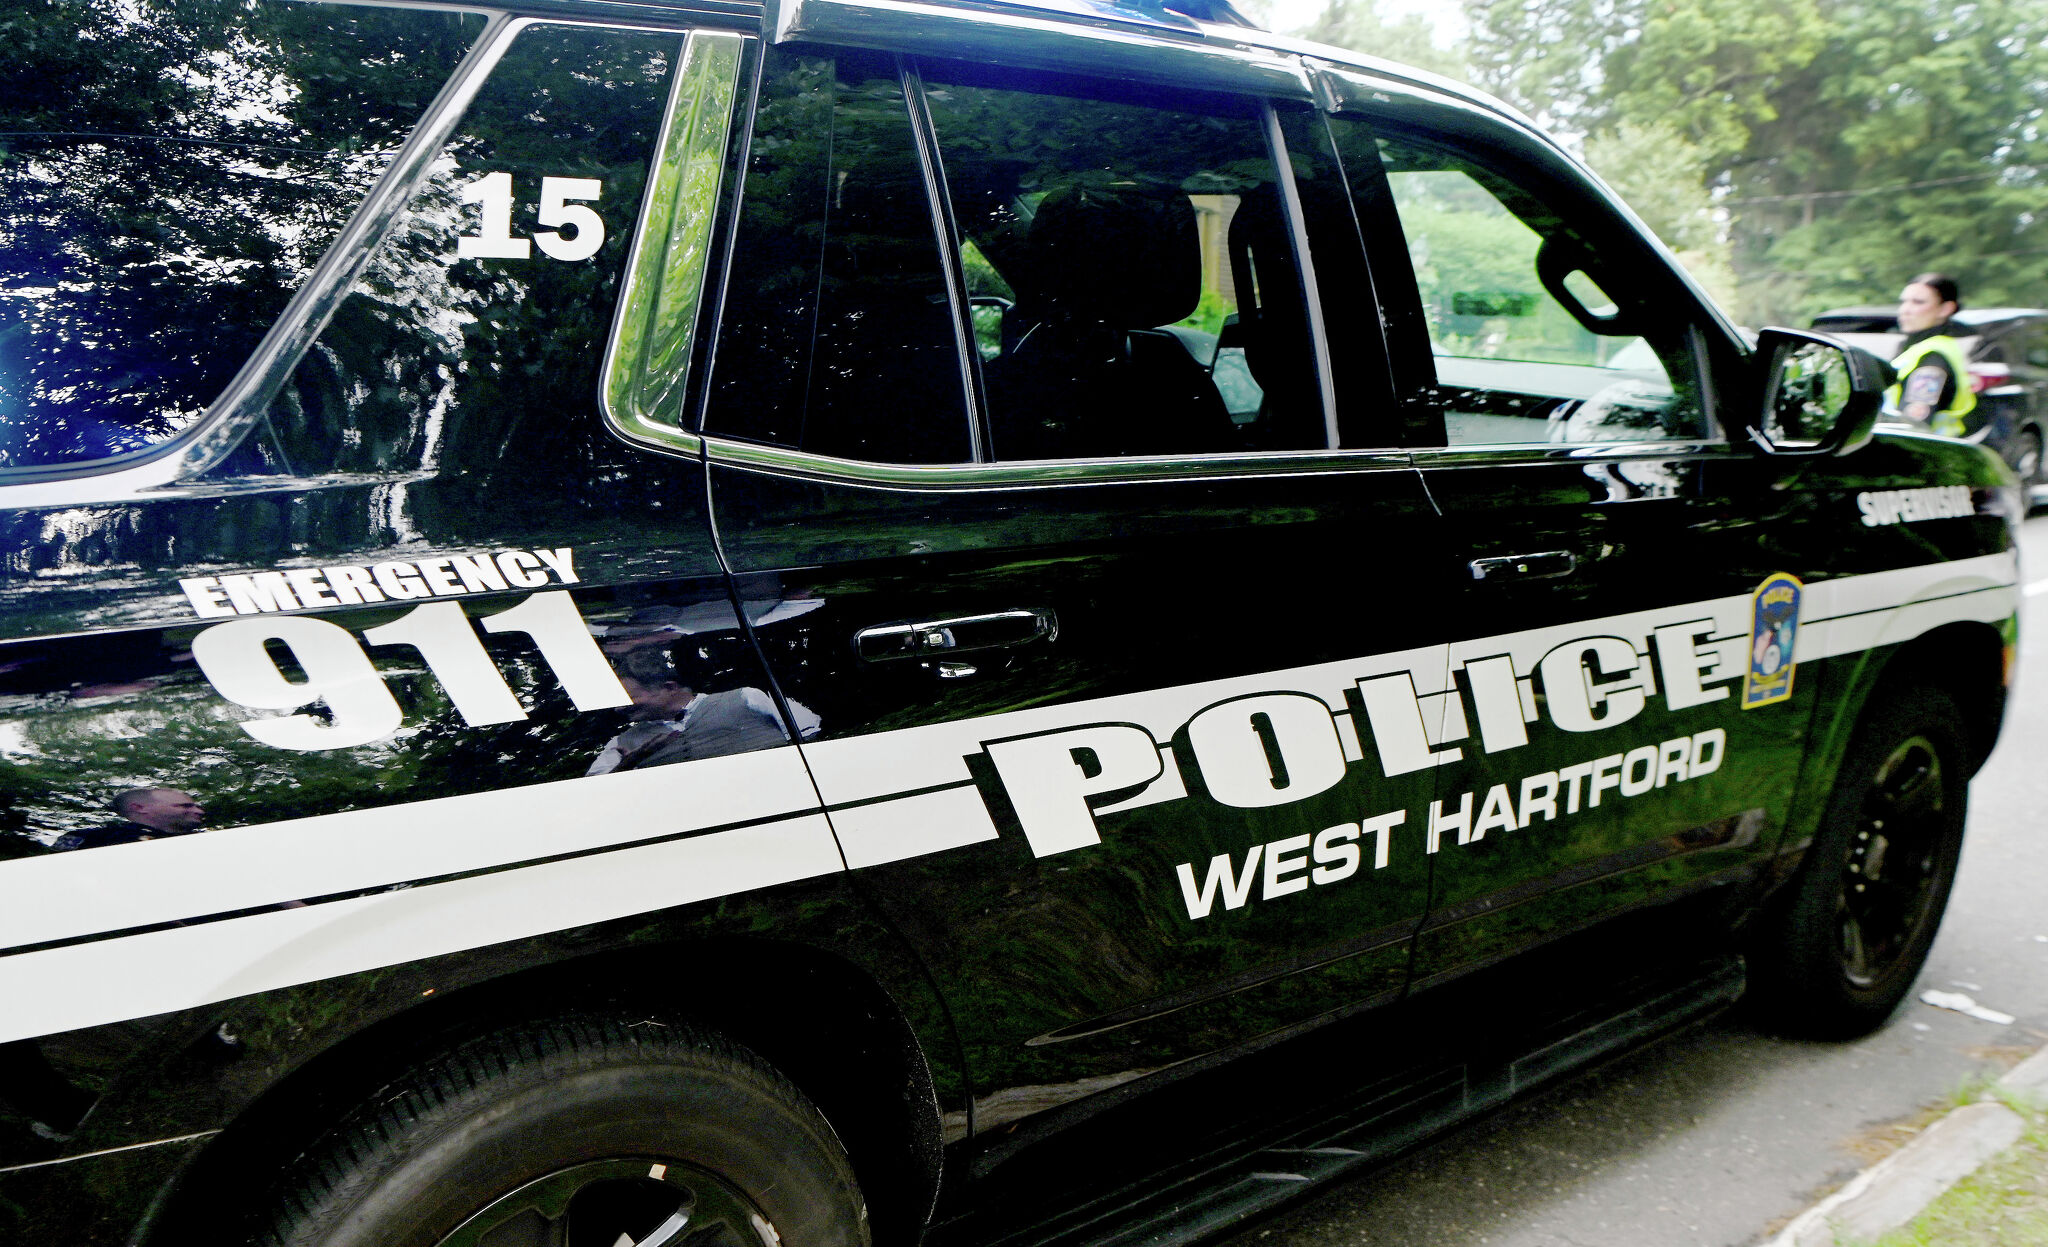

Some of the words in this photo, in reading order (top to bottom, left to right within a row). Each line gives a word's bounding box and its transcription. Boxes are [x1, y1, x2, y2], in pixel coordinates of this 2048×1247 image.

[458, 172, 605, 261] 15
[179, 548, 580, 618] EMERGENCY
[191, 590, 634, 751] 911
[984, 617, 1730, 858] POLICE
[1176, 810, 1405, 920] WEST
[1427, 728, 1726, 854] HARTFORD
